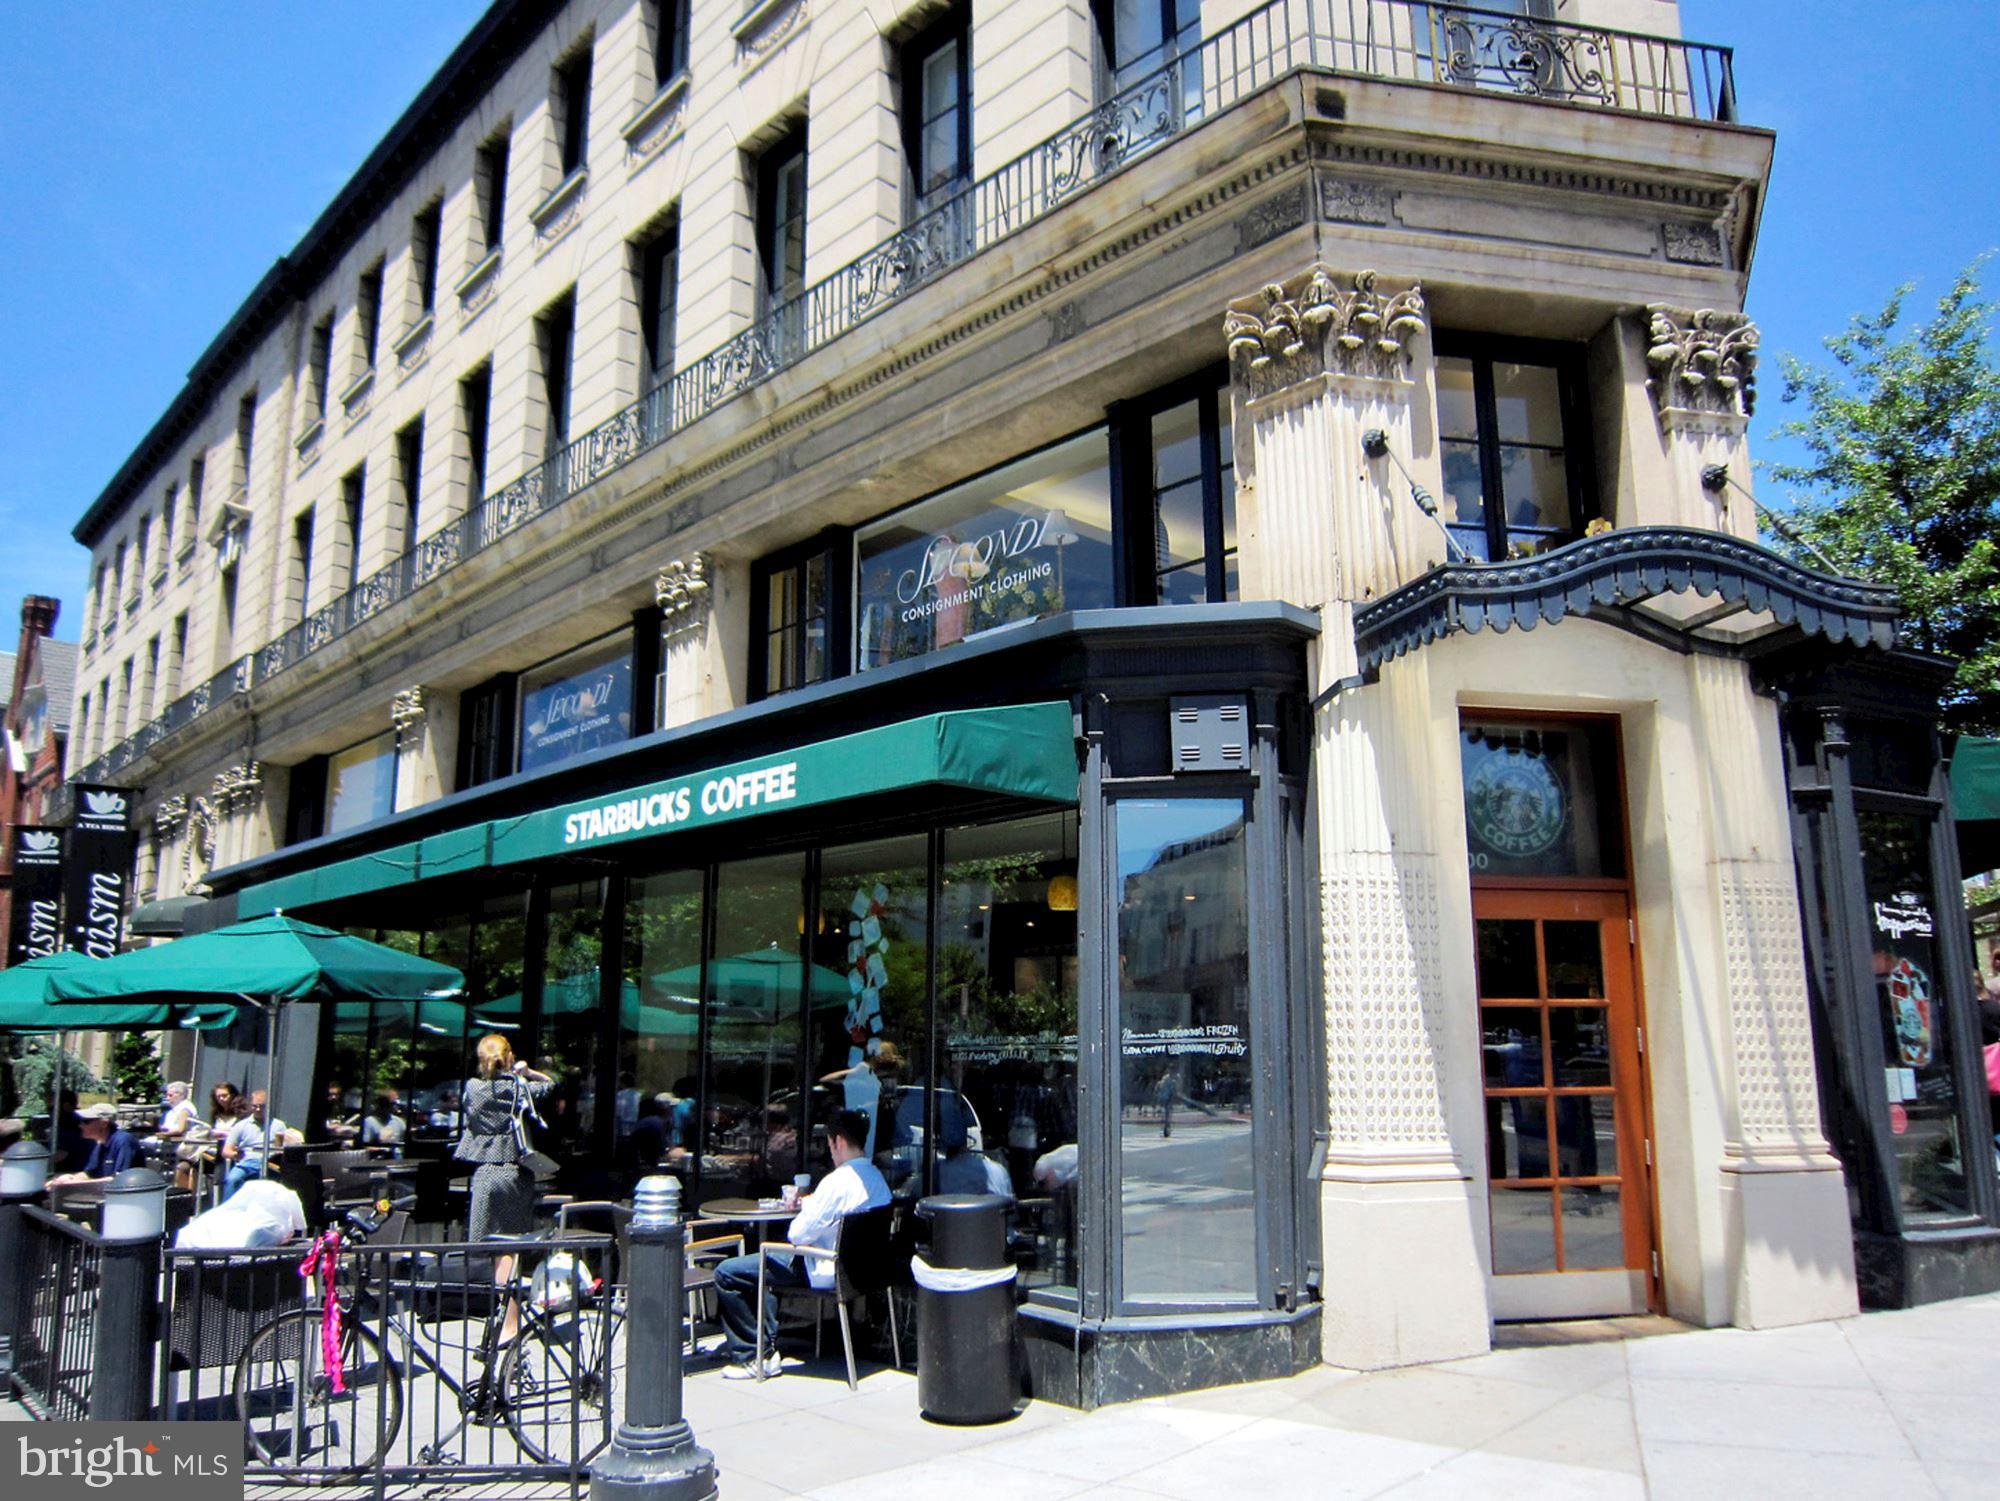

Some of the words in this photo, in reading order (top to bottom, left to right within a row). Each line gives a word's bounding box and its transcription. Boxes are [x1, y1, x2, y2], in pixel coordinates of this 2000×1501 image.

[897, 510, 1051, 604] SECONDI
[902, 586, 984, 623] CONSIGNMENT
[989, 563, 1051, 594] CLOTHING
[564, 787, 691, 844] STARBUCKS
[701, 762, 797, 815] COFFEE
[1484, 823, 1552, 851] COFFEE
